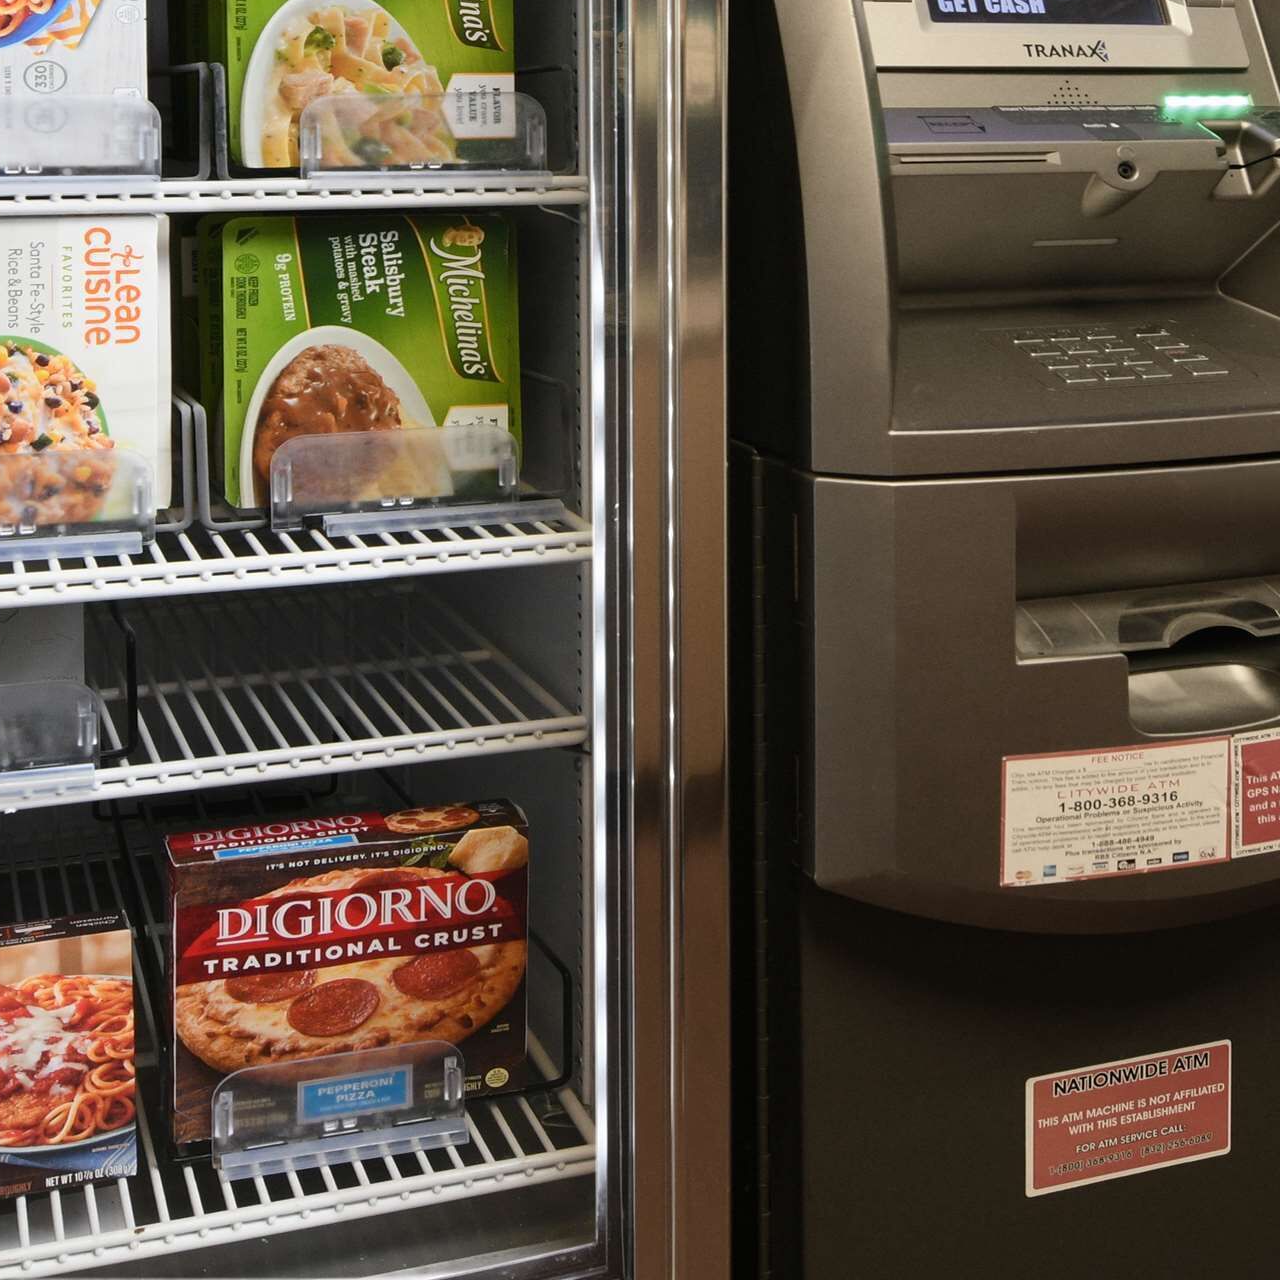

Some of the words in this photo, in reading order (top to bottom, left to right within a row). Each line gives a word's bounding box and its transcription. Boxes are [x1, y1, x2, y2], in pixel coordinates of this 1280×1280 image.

[1023, 41, 1104, 61] TRANAX
[34, 65, 47, 89] 330
[29, 240, 45, 279] Santa
[343, 235, 358, 258] with
[7, 248, 23, 275] Rice
[274, 253, 292, 270] 9g
[359, 233, 383, 294] Steak
[380, 230, 405, 317] Salisbury
[62, 246, 73, 329] FAVORITES
[83, 227, 111, 346] cuisine
[328, 236, 345, 279] potatoes
[337, 293, 352, 323] gravy
[347, 261, 364, 301] mashed
[7, 289, 23, 329] Beans
[26, 282, 45, 334] Fe-Style
[114, 270, 141, 345] Lean
[279, 274, 296, 321] PROTEIN
[430, 237, 486, 376] Michelina's
[1091, 756, 1109, 764] FEE
[1110, 752, 1144, 762] NOTICE
[1147, 778, 1181, 790] ATM
[1246, 774, 1268, 785] This
[1247, 787, 1269, 799] GPS
[1035, 812, 1082, 824] Operational
[1083, 809, 1120, 819] Problems
[1132, 803, 1174, 814] Suspicious
[1175, 799, 1203, 810] Activity
[1058, 790, 1179, 813] 1-800-368-9316
[1249, 801, 1268, 812] and
[192, 815, 365, 845] DIGIORNO
[1257, 814, 1276, 825] this
[193, 833, 310, 852] TRADITIONAL
[316, 826, 370, 838] CRUST
[266, 863, 285, 871] IT'S
[288, 859, 310, 869] NOT
[313, 854, 368, 866] DELIVERY.
[371, 850, 390, 859] IT'S
[215, 879, 497, 942] DIGIORNO
[203, 936, 402, 975] TRADITIONAL
[414, 923, 504, 949] CRUST
[317, 1077, 394, 1097] PEPPERONI
[1052, 1060, 1170, 1098] NATIONWIDE
[1171, 1051, 1211, 1074] ATM
[336, 1089, 376, 1102] PIZZA
[1038, 1116, 1059, 1129] THIS
[1061, 1111, 1084, 1124] ATM
[1085, 1101, 1135, 1119] MACHINE
[1137, 1098, 1147, 1108] IS
[1148, 1093, 1171, 1106] NOT
[1172, 1082, 1226, 1102] AFFILIATED
[1068, 1122, 1095, 1136] WITH
[1097, 1117, 1119, 1130] THIS
[1120, 1102, 1197, 1126] ESTABLISHMENT
[1075, 1142, 1098, 1154] FOR
[1099, 1137, 1119, 1149] ATM
[1120, 1130, 1159, 1145] SERVICE
[45, 1175, 61, 1188] NET
[62, 1173, 74, 1185] WT
